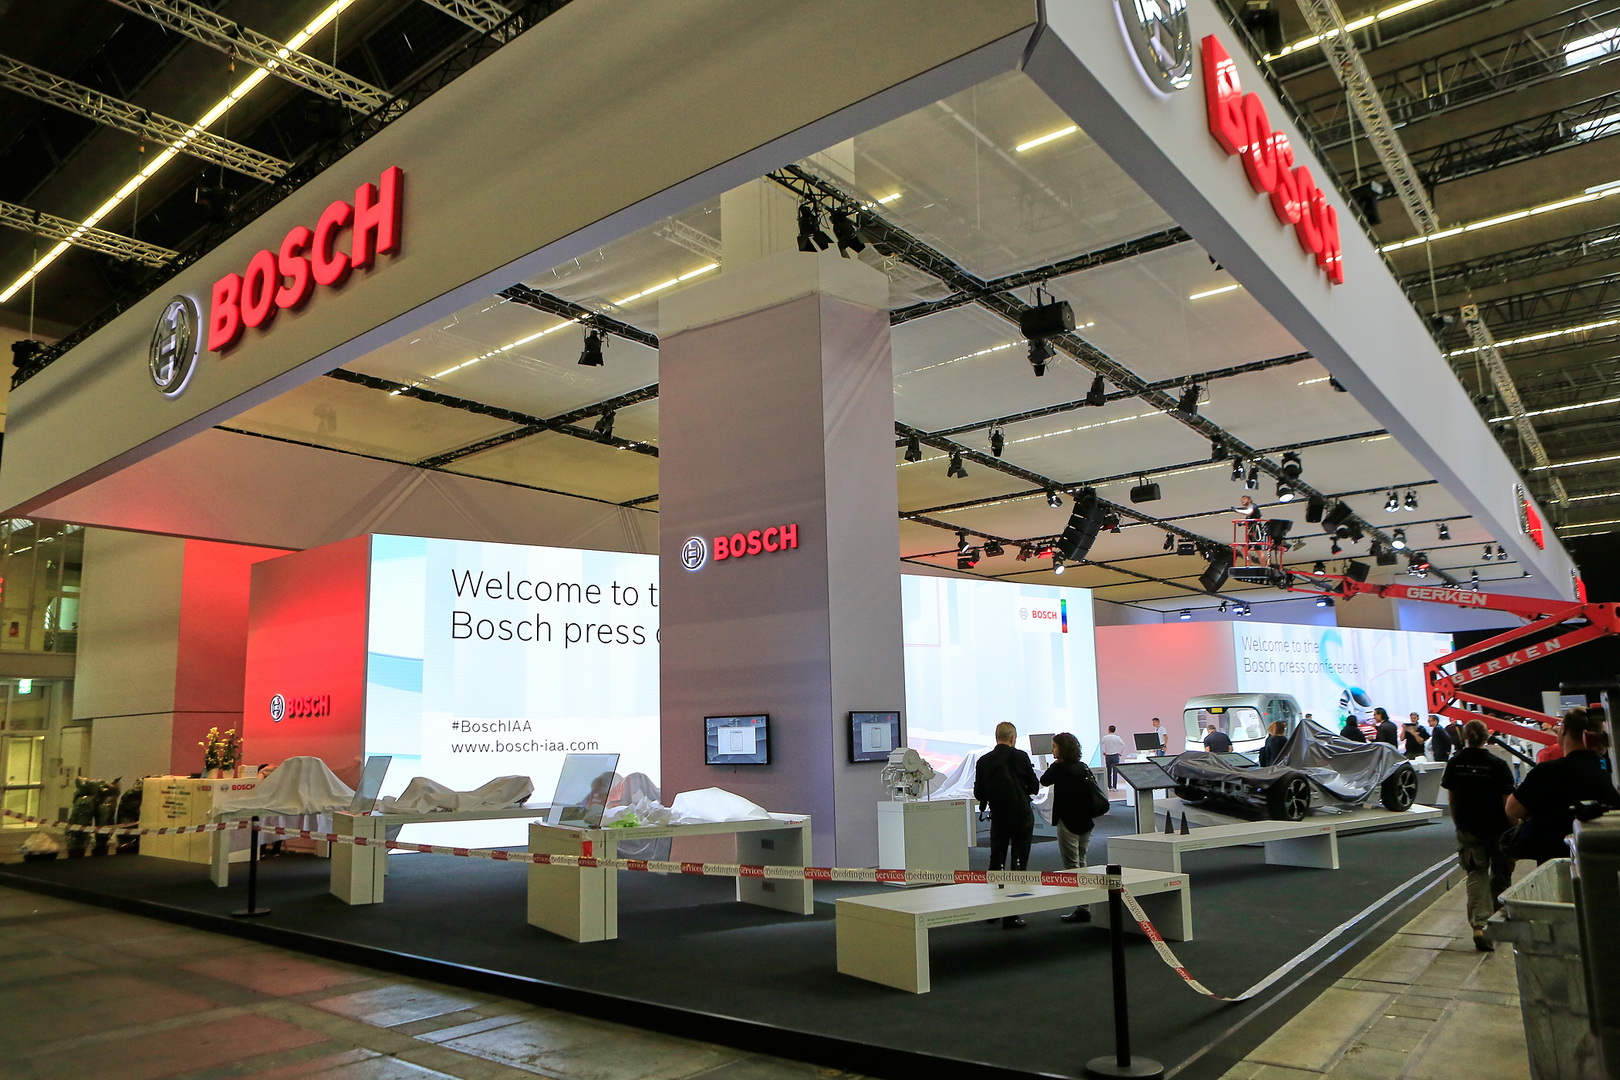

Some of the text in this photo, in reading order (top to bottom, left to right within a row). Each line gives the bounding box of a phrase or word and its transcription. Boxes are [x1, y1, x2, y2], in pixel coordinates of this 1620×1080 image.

[1202, 34, 1343, 285] BOSCH
[208, 166, 404, 352] BOSCH
[713, 523, 798, 561] BOSCH
[452, 569, 600, 604] Welcome
[611, 581, 639, 606] to
[1407, 587, 1488, 605] GERKEN
[1032, 610, 1057, 619] BOSCH
[452, 611, 551, 642] Bosch
[565, 622, 646, 649] press
[1242, 636, 1320, 653] Welcome to the
[1244, 657, 1359, 675] Bosch press conference
[1452, 638, 1561, 684] GERKEN
[287, 695, 330, 718] BOSCH
[452, 720, 532, 733] #BoschIAA
[451, 739, 599, 753] www.bosch-iaa.com
[875, 871, 905, 880] services
[954, 872, 986, 882] services
[1042, 874, 1077, 884] services
